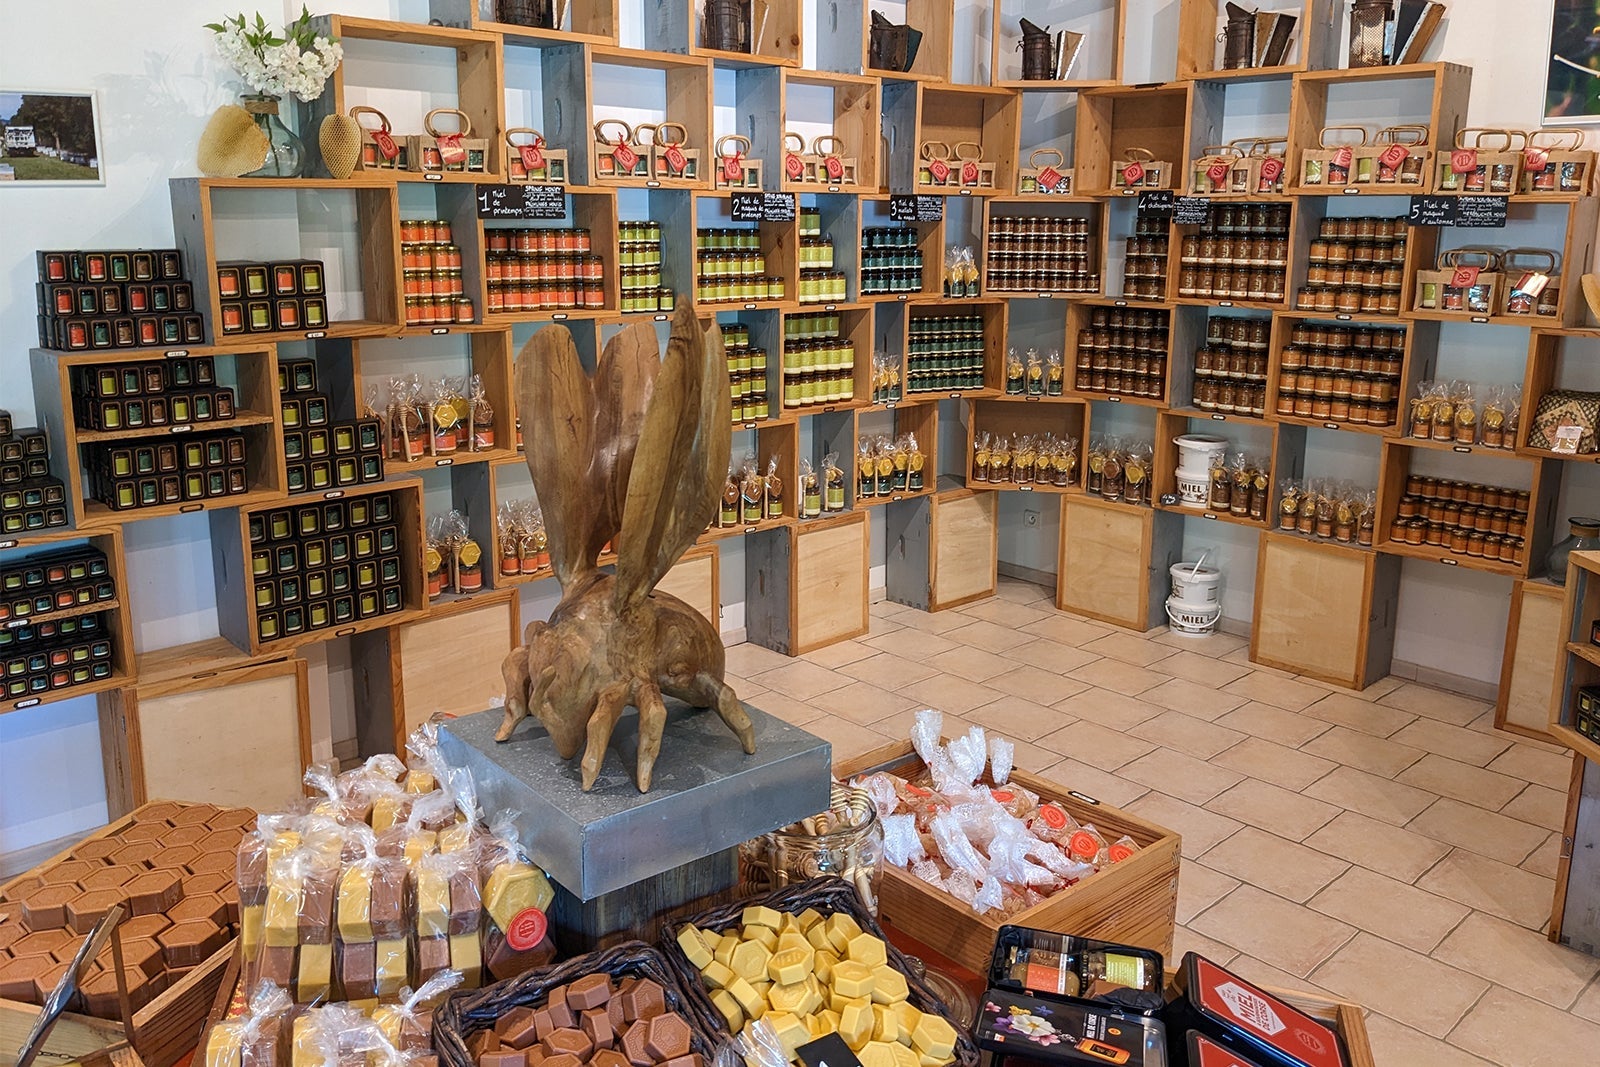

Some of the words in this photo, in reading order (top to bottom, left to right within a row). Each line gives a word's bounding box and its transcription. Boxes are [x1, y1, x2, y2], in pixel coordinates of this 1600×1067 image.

[492, 188, 507, 198] Miel
[478, 191, 490, 212] 1
[492, 199, 501, 207] de
[741, 195, 751, 204] Miel
[753, 196, 760, 205] de
[1138, 196, 1147, 212] 4
[1423, 199, 1438, 209] Miel
[1441, 201, 1450, 210] de
[493, 206, 523, 217] printemps
[732, 198, 740, 216] 2
[891, 200, 897, 217] 3
[1410, 204, 1420, 219] 5
[741, 212, 762, 220] printemps
[1422, 210, 1445, 218] maquis
[1421, 217, 1454, 226] d'automne
[1180, 482, 1203, 493] MIEL
[1181, 614, 1205, 624] MIEL
[1237, 992, 1256, 1023] MIEL
[1258, 1000, 1270, 1022] CORSE
[1261, 1020, 1271, 1032] DE
